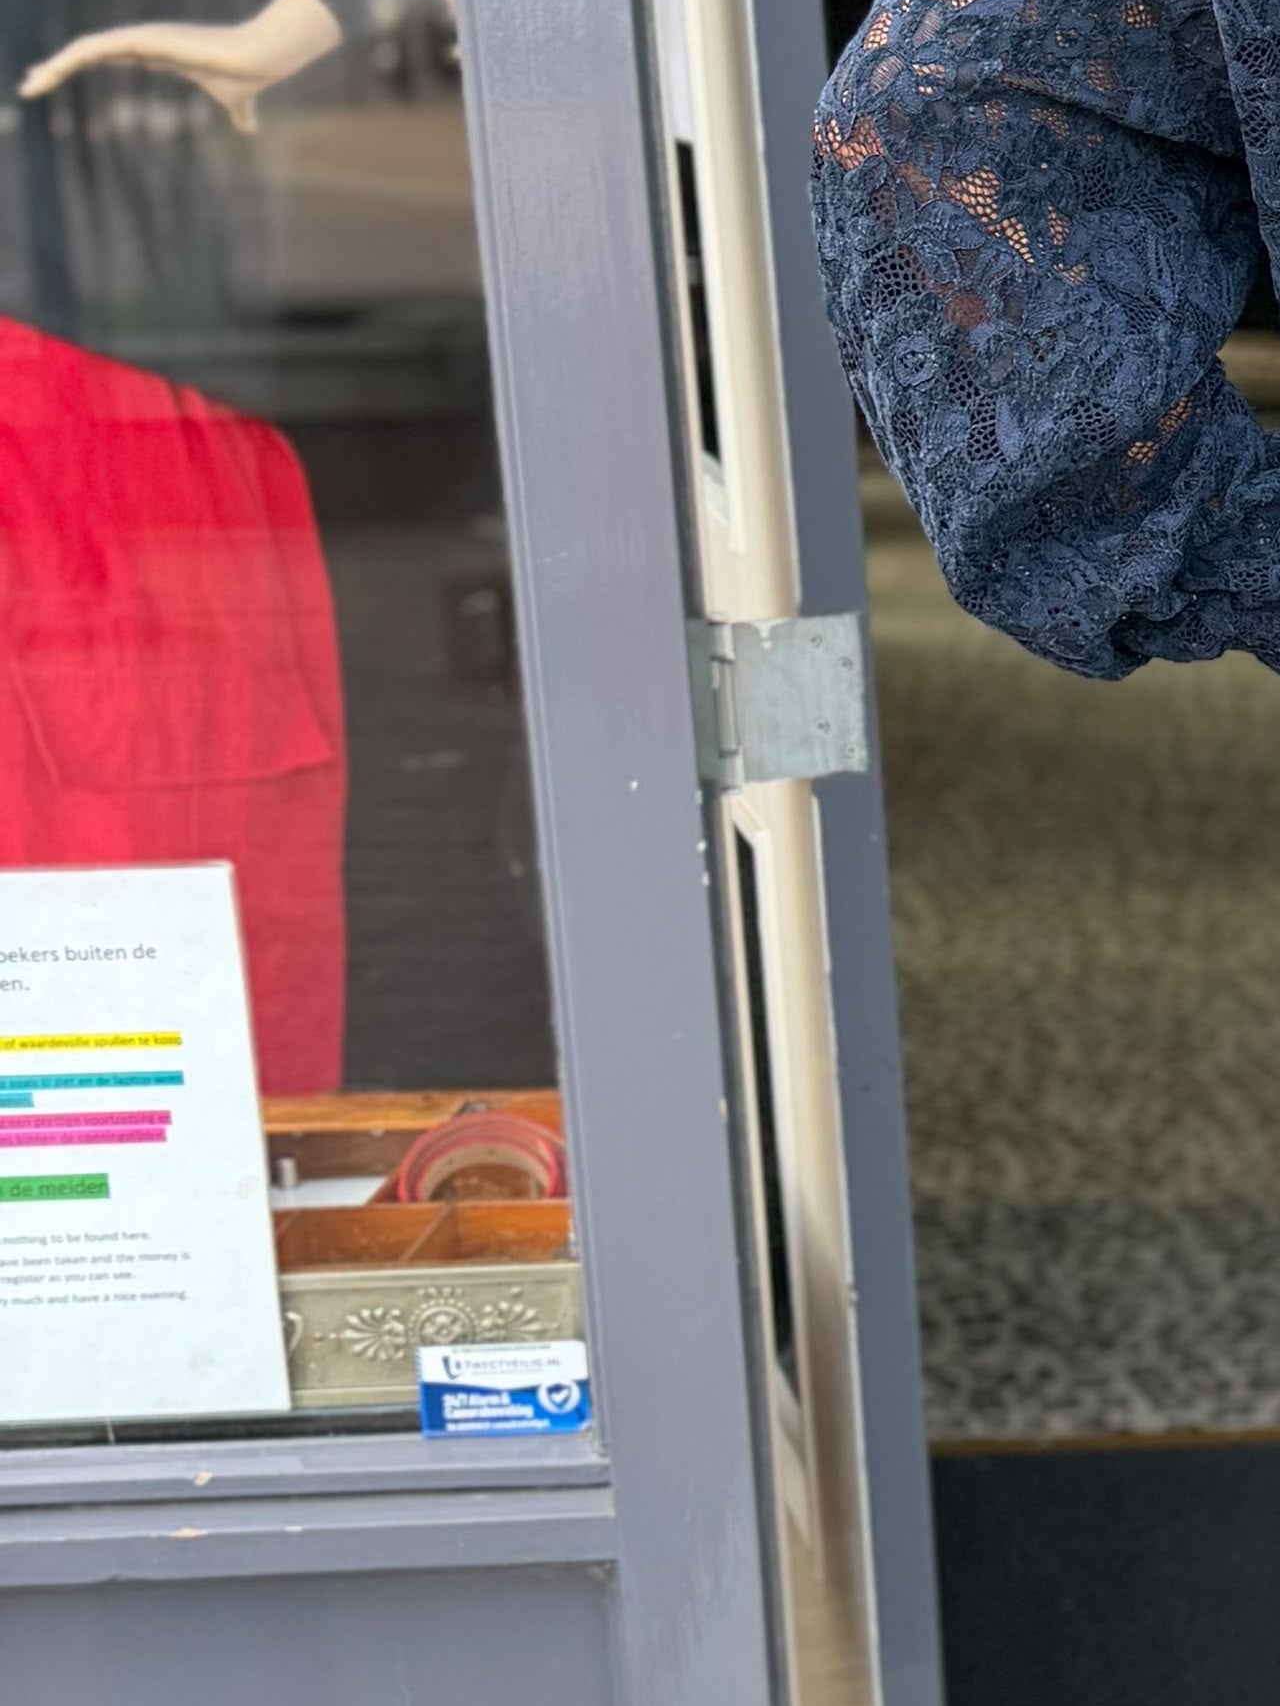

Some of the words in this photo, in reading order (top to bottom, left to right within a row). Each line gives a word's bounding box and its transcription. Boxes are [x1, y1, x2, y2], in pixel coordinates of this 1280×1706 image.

[0, 946, 60, 963] oekers
[65, 945, 127, 961] buiten
[133, 943, 157, 959] de
[138, 1035, 150, 1045] te
[9, 1181, 33, 1197] de
[39, 1177, 108, 1195] meiden
[51, 1234, 64, 1243] to
[66, 1233, 81, 1242] be
[84, 1231, 118, 1242] found
[54, 1255, 88, 1265] taken
[90, 1254, 113, 1264] and
[115, 1253, 135, 1263] the
[138, 1253, 178, 1263] money
[64, 1273, 86, 1284] you
[89, 1272, 109, 1281] can
[12, 1294, 44, 1305] much
[47, 1294, 69, 1304] and
[72, 1293, 99, 1304] have
